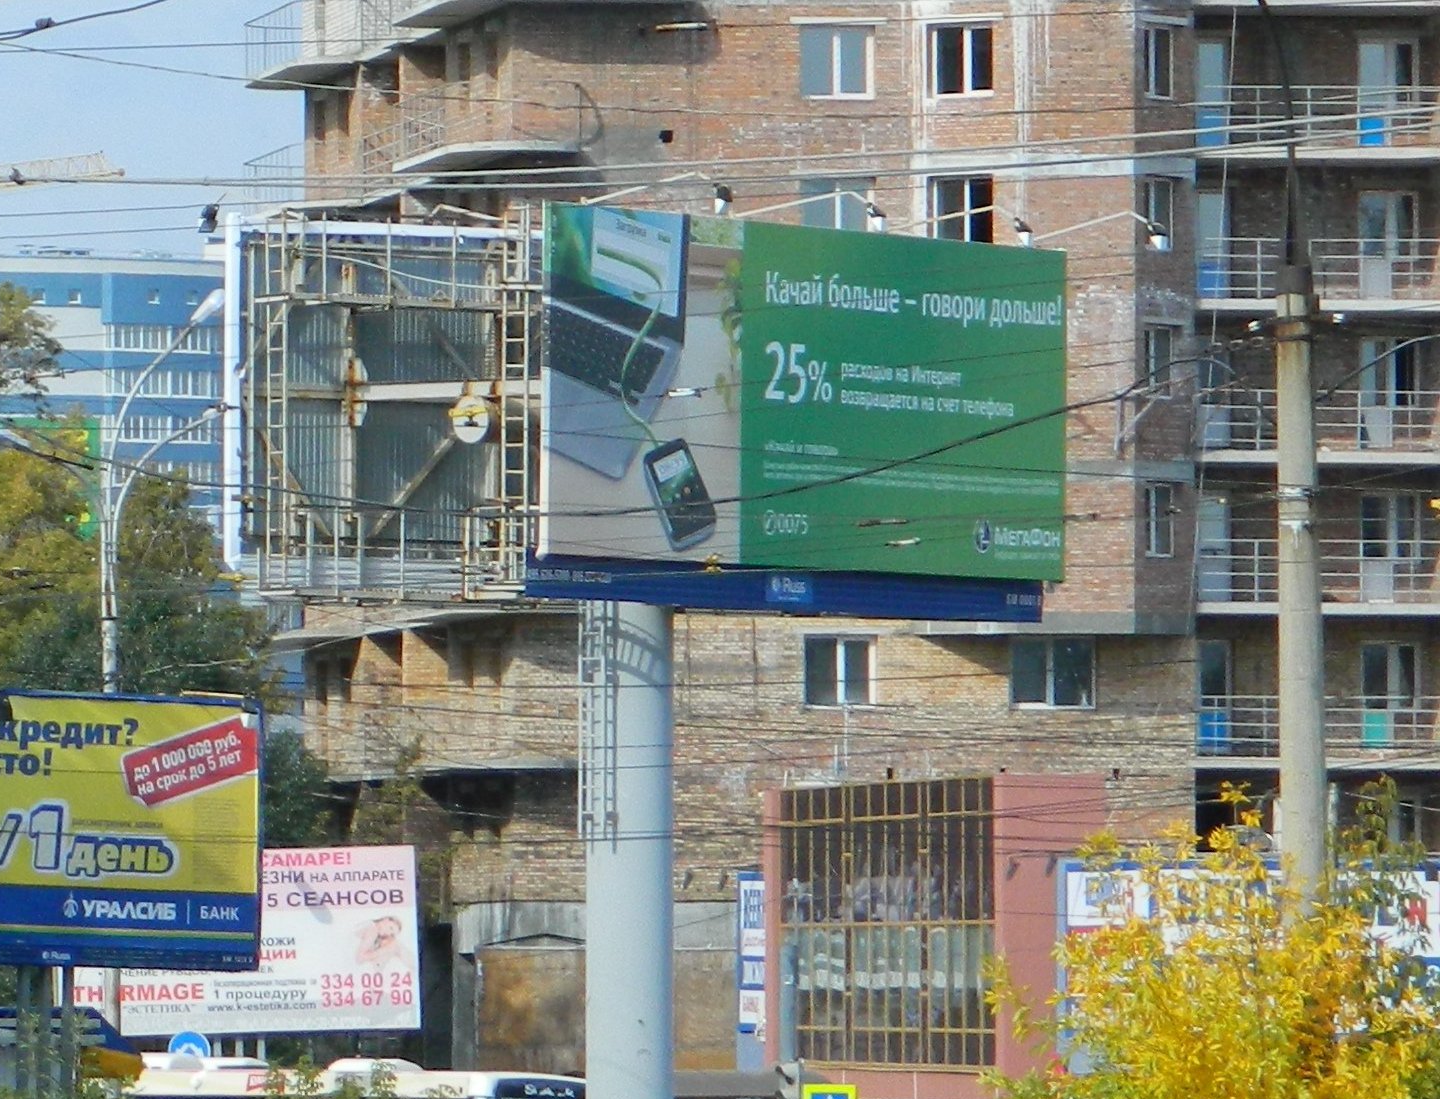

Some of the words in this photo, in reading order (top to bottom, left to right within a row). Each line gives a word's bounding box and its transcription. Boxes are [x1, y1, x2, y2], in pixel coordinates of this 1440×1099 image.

[765, 270, 823, 306] Качай
[828, 273, 900, 314] больше
[921, 291, 986, 328] говори
[988, 295, 1063, 328] дольше!
[764, 341, 833, 404] 25%
[841, 362, 894, 383] расходов
[895, 367, 909, 383] на
[911, 366, 962, 389] Интернет
[840, 389, 919, 411] возвращается
[921, 396, 935, 411] на
[962, 397, 1015, 420] телефона
[776, 513, 808, 535] 0075
[133, 764, 151, 781] до
[151, 756, 160, 772] 1
[161, 748, 186, 770] 000
[187, 739, 212, 760] 000
[214, 730, 242, 754] руб.
[136, 781, 155, 796] на
[156, 769, 187, 791] срок
[189, 763, 206, 780] до
[206, 755, 217, 771] 5
[219, 749, 242, 768] лет
[65, 834, 175, 878] день
[261, 851, 352, 868] САМАРЕ!
[309, 872, 330, 883] НА
[333, 869, 405, 882] АППАРАТЕ
[267, 892, 278, 908] 5
[286, 889, 405, 907] СЕАНСОВ
[81, 898, 177, 921] УРАЛСИБ
[199, 904, 241, 922] БАНК
[321, 973, 355, 990] 334
[361, 972, 384, 988] 00
[390, 971, 413, 988] 24
[73, 983, 205, 1003] THRMAGE
[214, 989, 220, 999] 1
[226, 989, 308, 1002] процедуру
[321, 991, 355, 1007] 334
[361, 990, 384, 1007] 67
[390, 989, 413, 1005] 90
[207, 1001, 317, 1012] www.k-estetika.com
